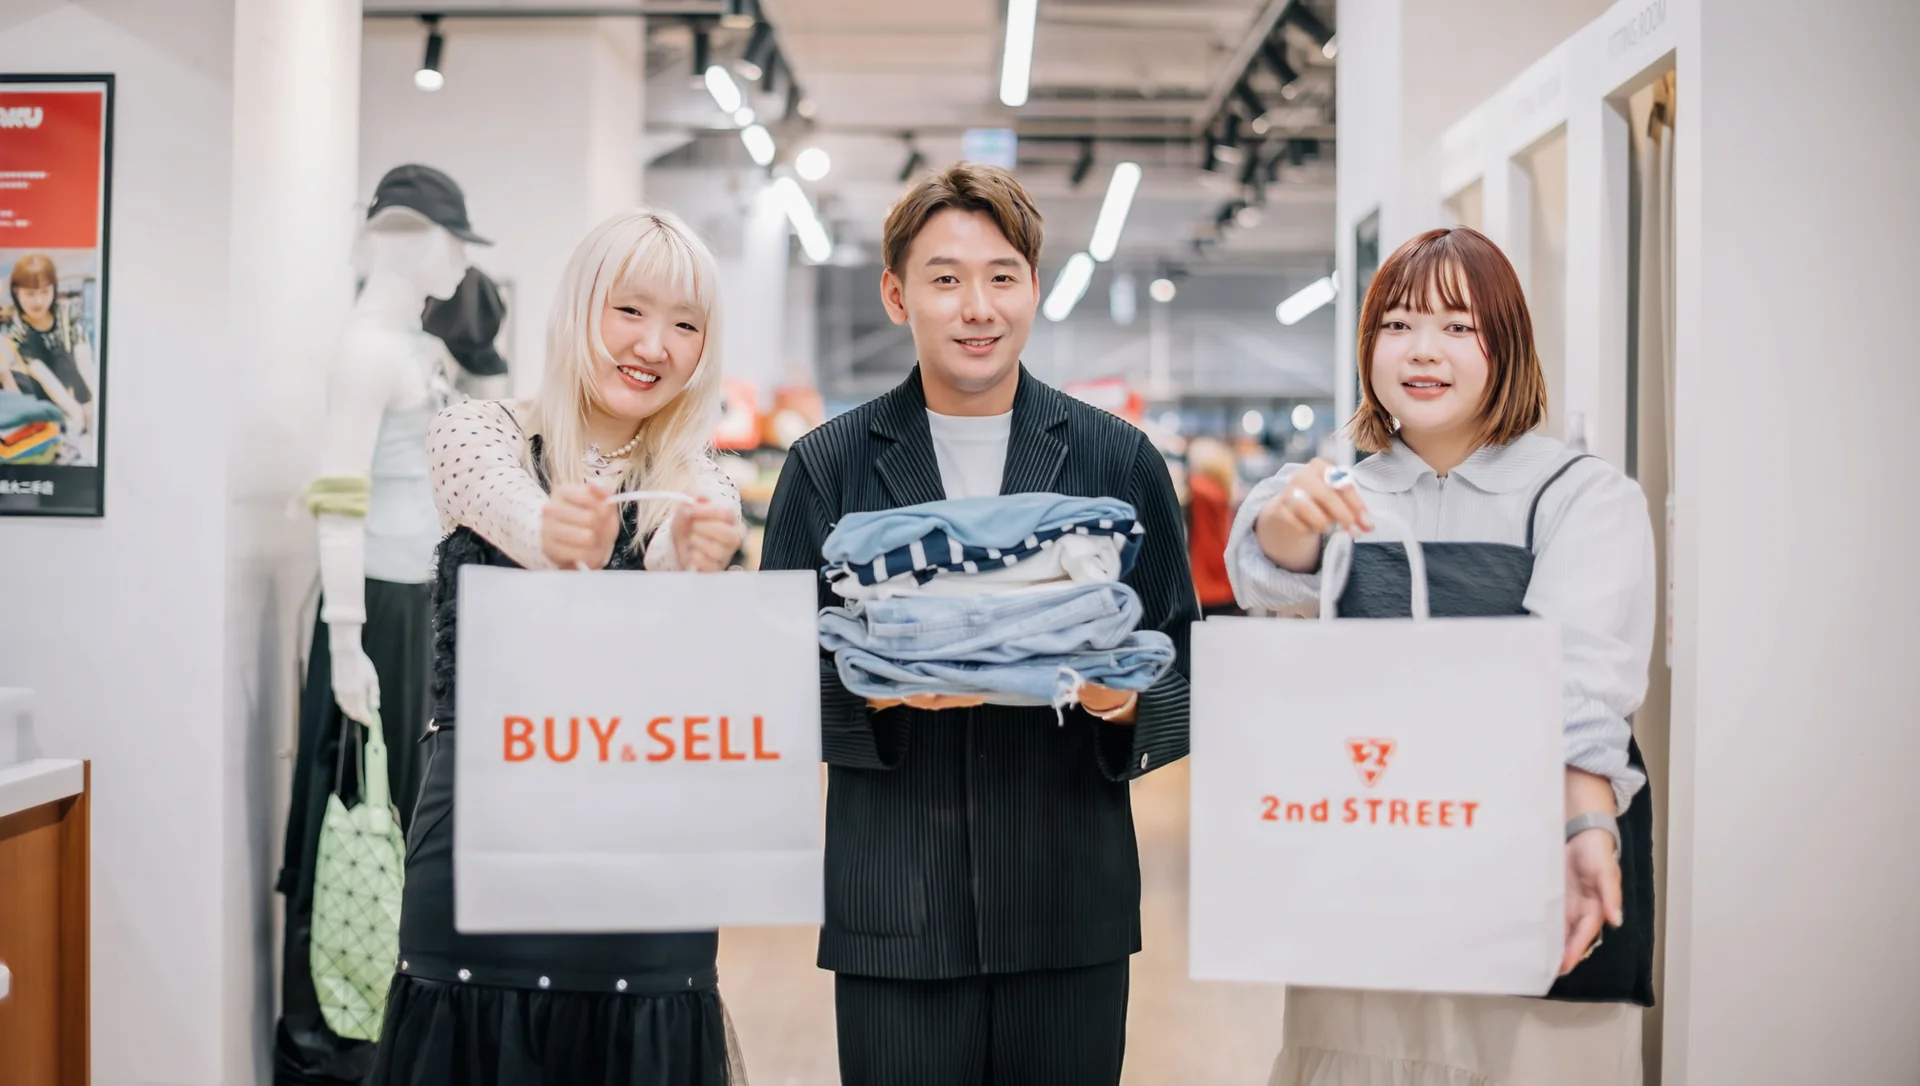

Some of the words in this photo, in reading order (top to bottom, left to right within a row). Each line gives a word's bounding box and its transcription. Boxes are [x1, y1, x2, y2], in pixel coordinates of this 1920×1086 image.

[502, 715, 621, 763] BUY
[621, 744, 638, 762] &
[645, 715, 782, 763] SELL
[1261, 795, 1329, 823] 2nd
[1342, 797, 1479, 828] STREET
